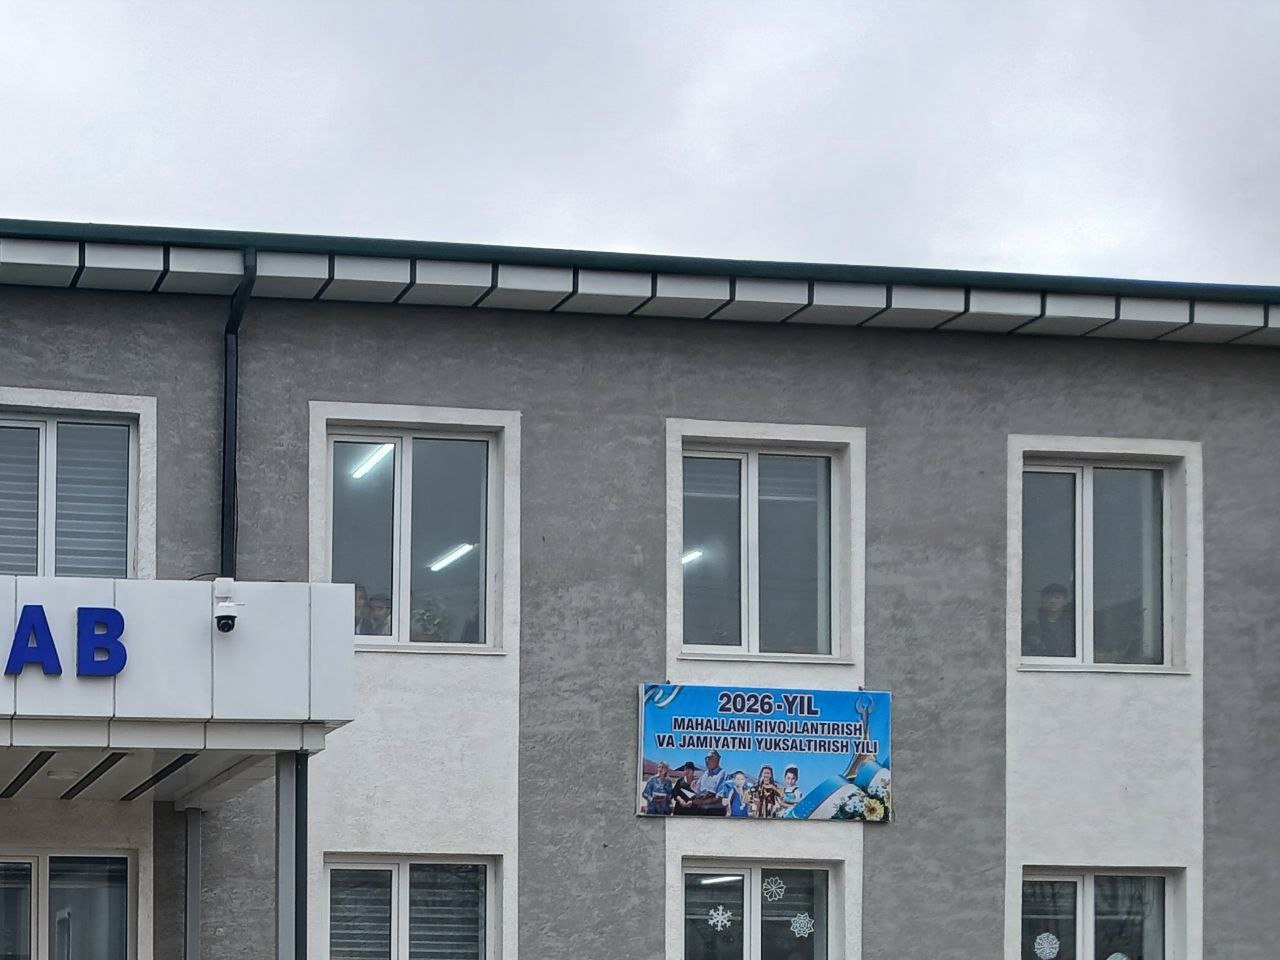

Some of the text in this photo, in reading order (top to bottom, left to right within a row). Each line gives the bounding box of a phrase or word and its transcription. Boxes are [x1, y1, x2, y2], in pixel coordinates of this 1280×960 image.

[672, 717, 863, 736] MAHALLANI RIVOJLANTIRISH
[656, 734, 879, 755] VA JAMIYATNI YUKSALTIRISH YILI
